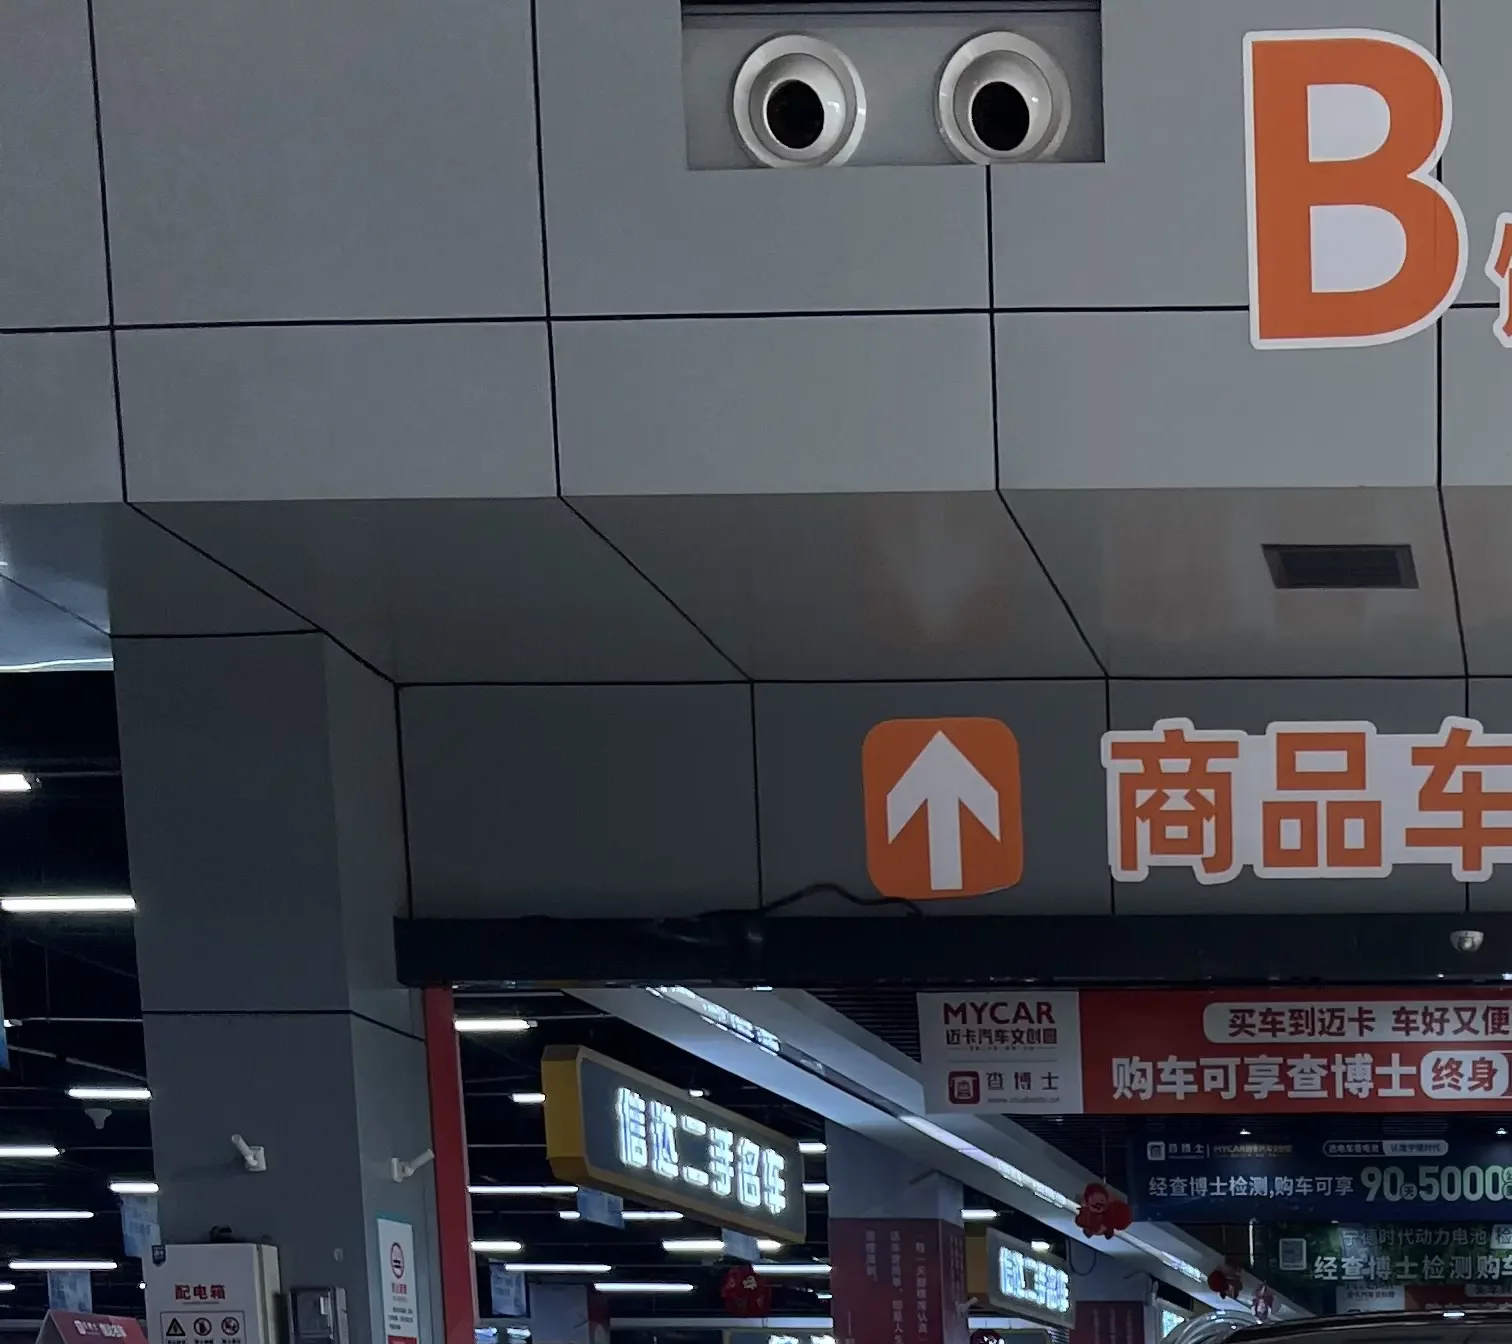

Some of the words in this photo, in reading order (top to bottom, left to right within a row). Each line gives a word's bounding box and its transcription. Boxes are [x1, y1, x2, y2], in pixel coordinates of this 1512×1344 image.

[1246, 32, 1466, 345] B
[943, 1001, 1056, 1025] MYCAR
[1228, 1007, 1376, 1039] 买车到迈卡
[985, 1071, 1060, 1091] 查博士
[615, 1086, 787, 1216] 信达二手名车
[174, 1283, 226, 1301] 配电箱
